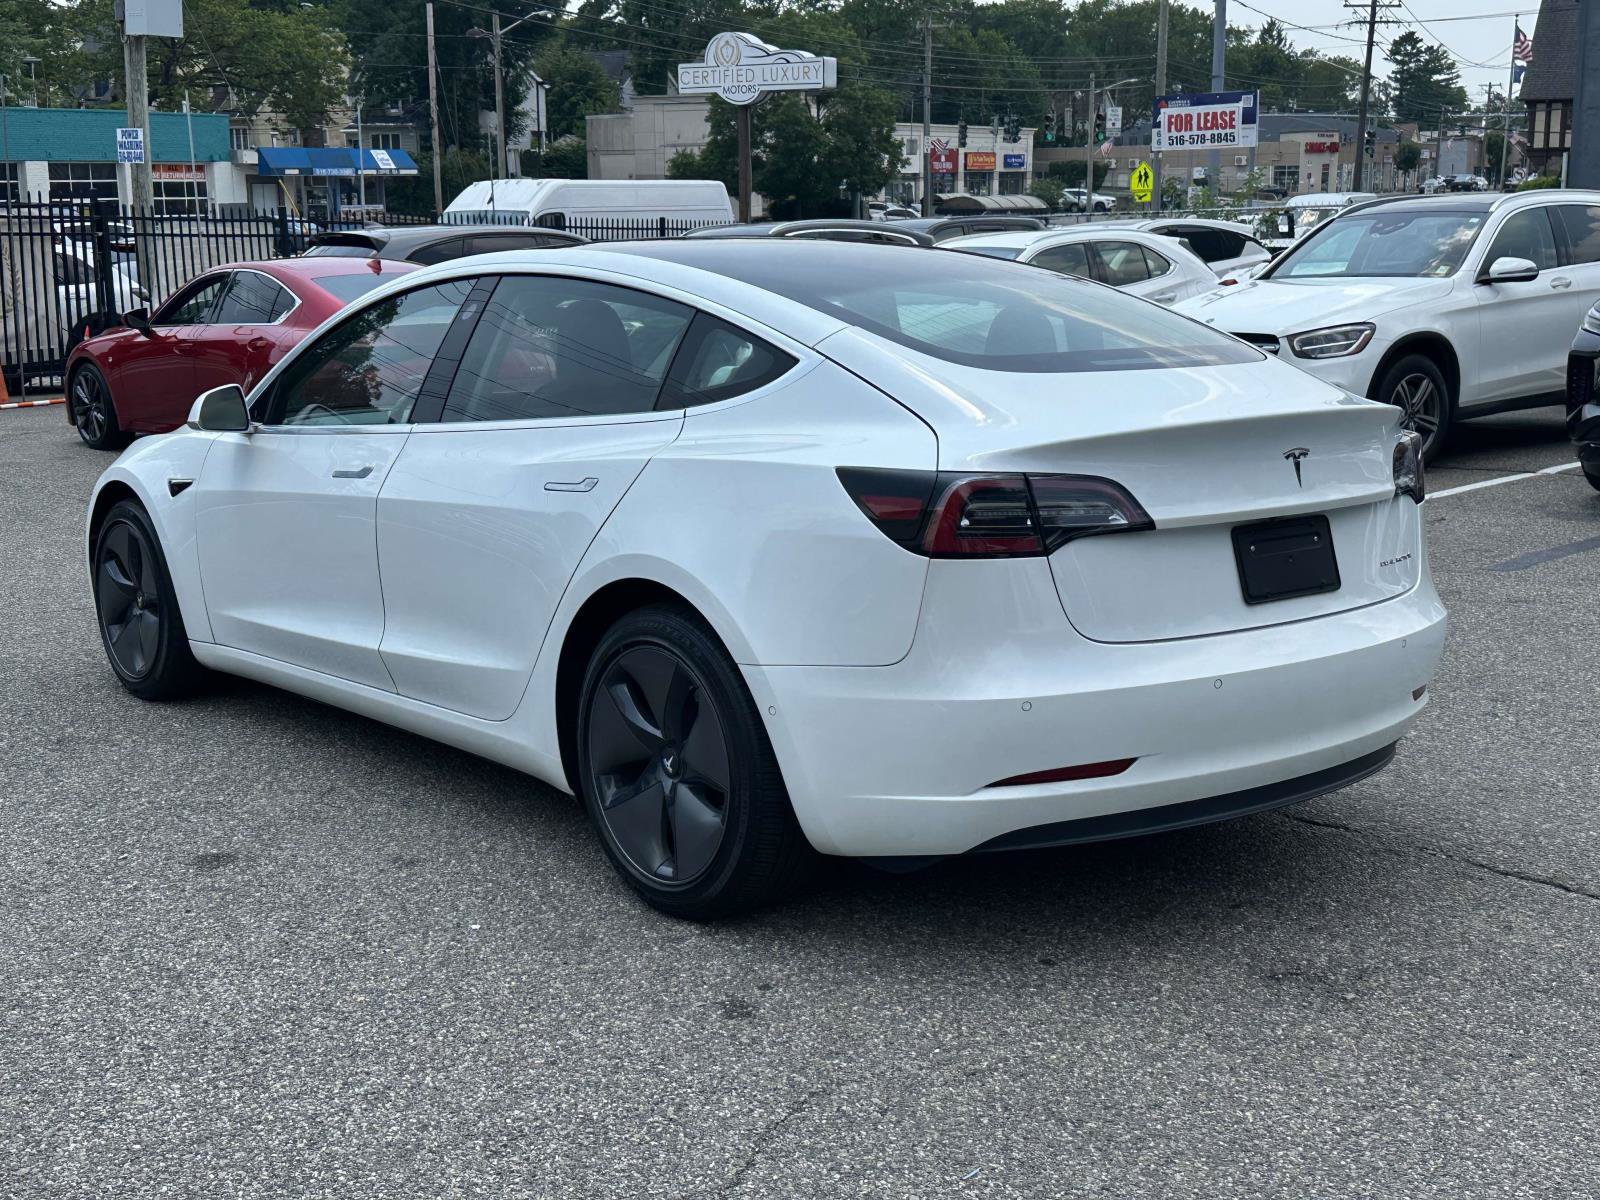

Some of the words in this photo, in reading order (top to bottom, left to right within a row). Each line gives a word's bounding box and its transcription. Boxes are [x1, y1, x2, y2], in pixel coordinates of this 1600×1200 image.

[680, 68, 755, 85] CERTIFIED
[762, 65, 822, 82] LUXURY
[722, 84, 757, 95] MOTORS
[1167, 113, 1193, 133] FOR
[1196, 110, 1236, 132] LEASE
[121, 129, 139, 139] POWER
[1168, 132, 1236, 146] 516-578-8845
[118, 140, 143, 150] WASHING
